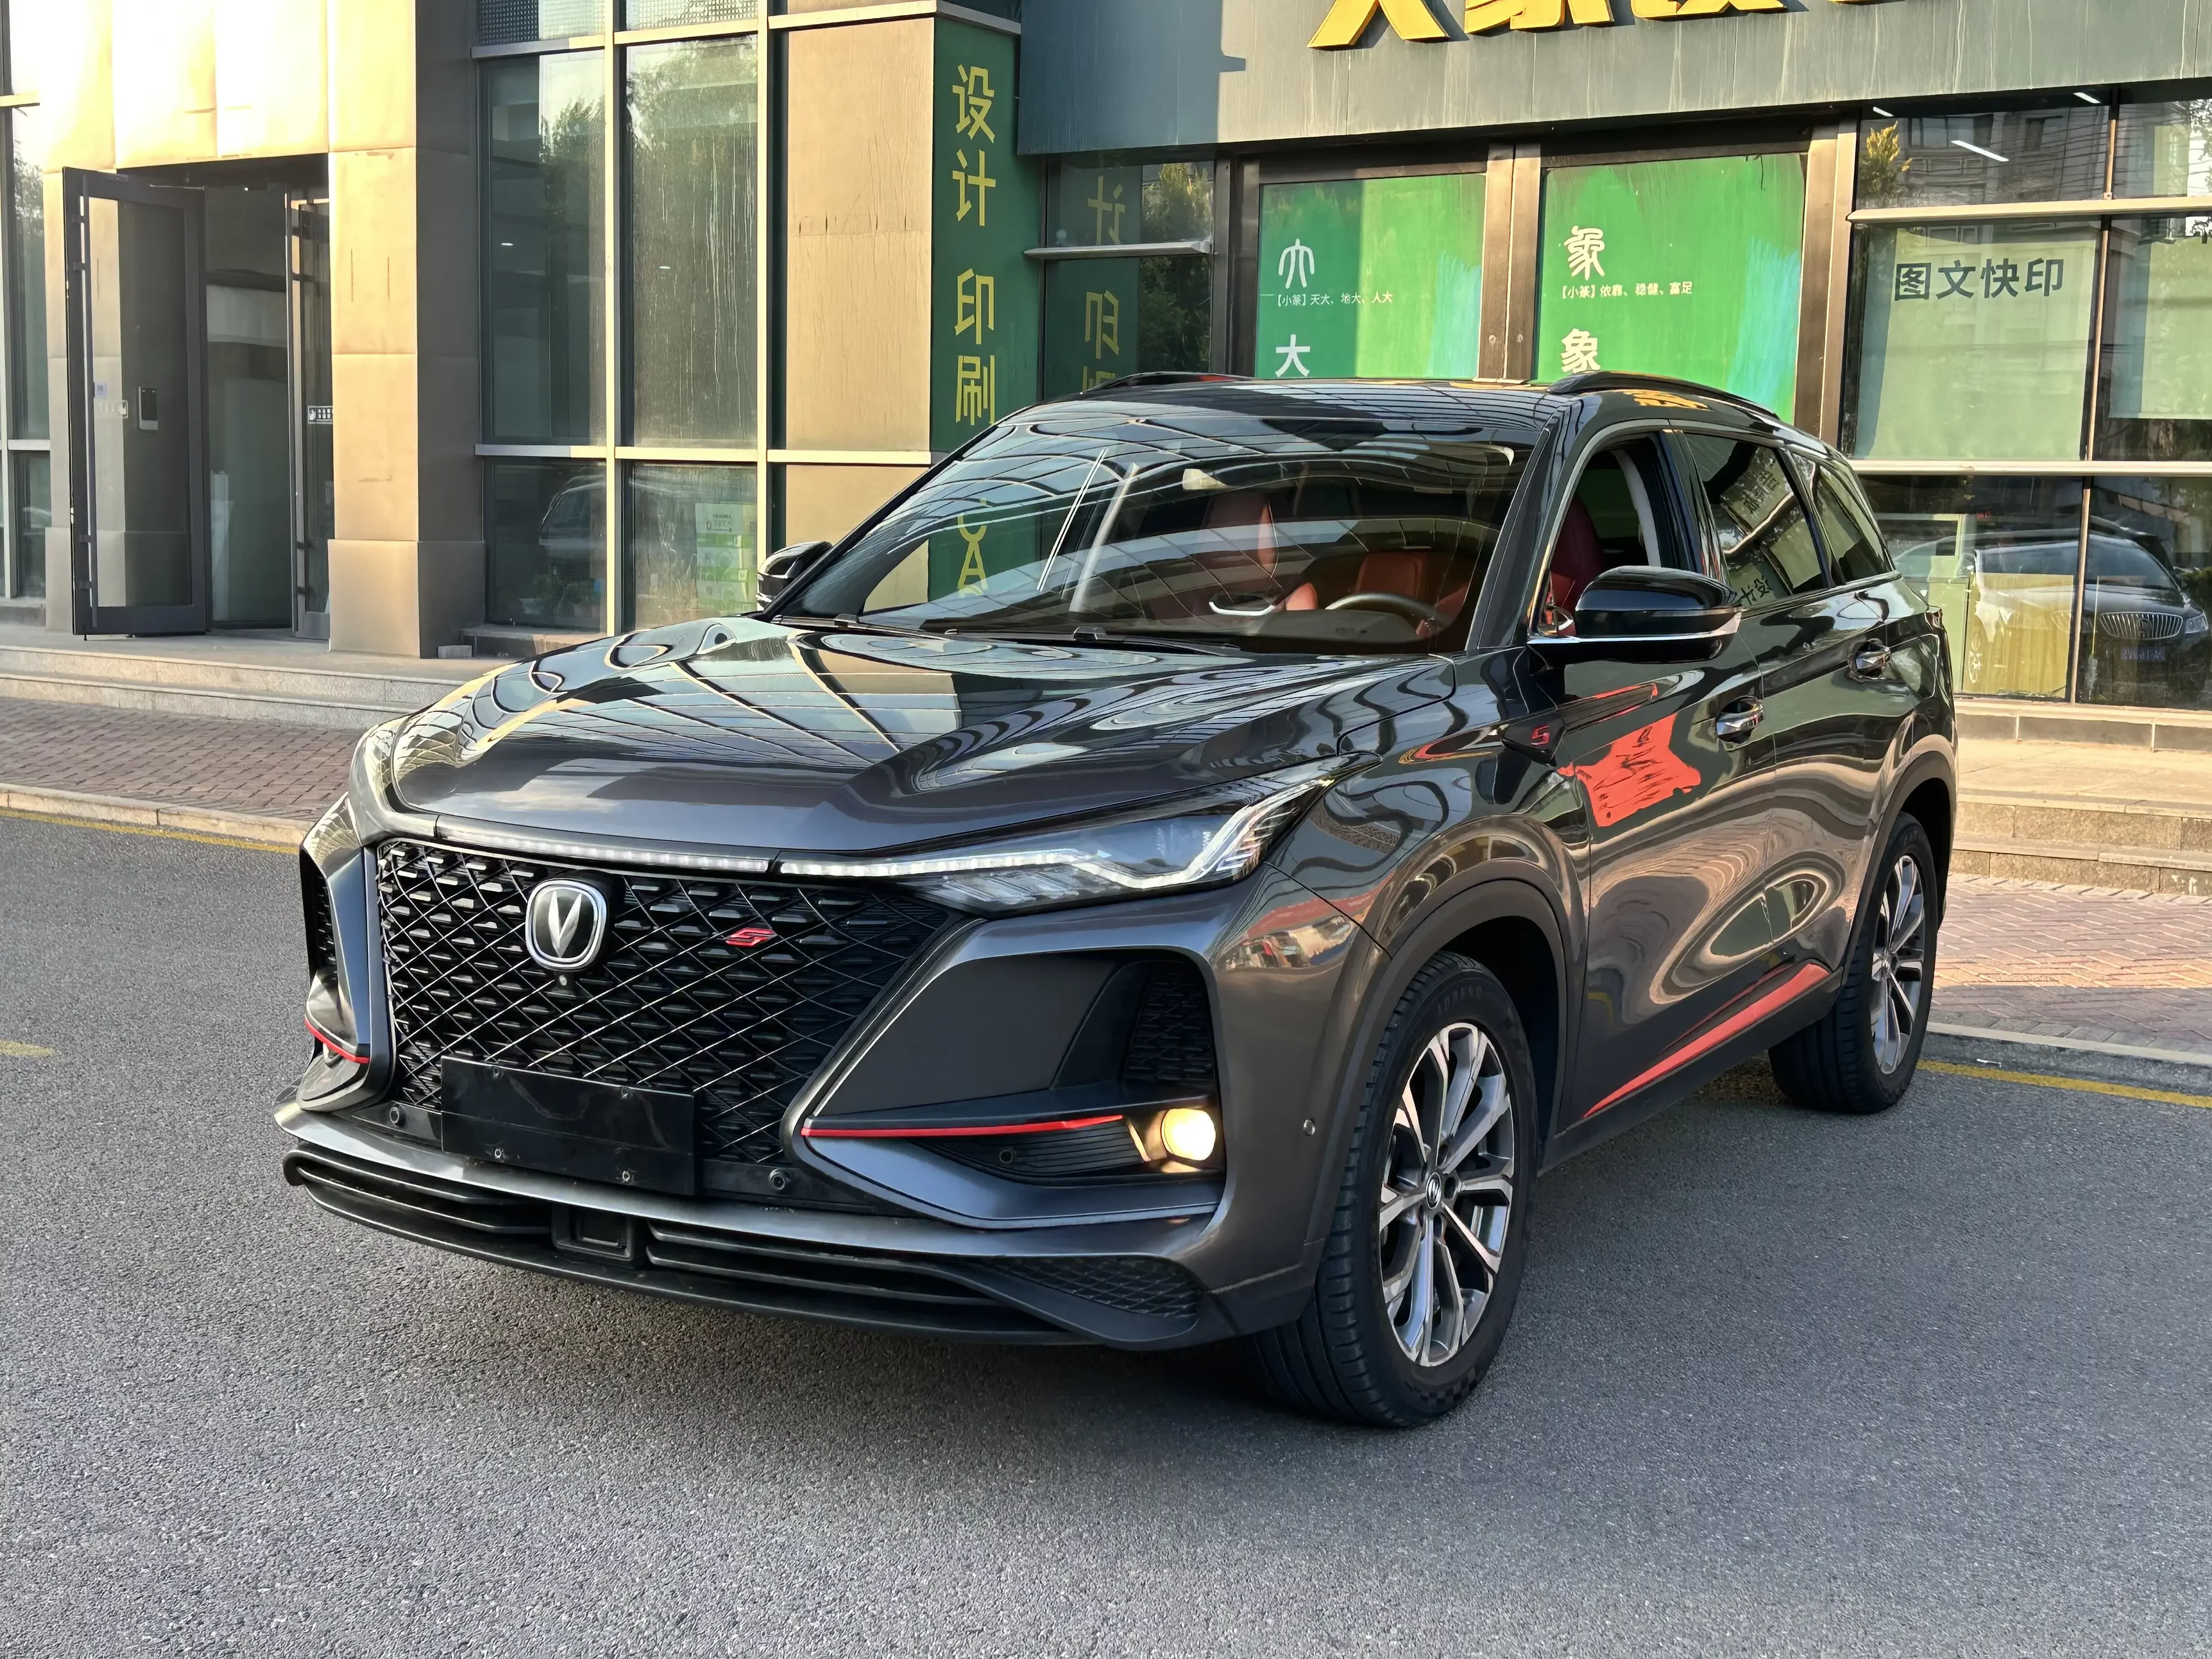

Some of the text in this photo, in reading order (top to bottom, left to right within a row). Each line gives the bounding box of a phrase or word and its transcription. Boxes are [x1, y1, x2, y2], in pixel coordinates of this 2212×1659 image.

[952, 64, 996, 425] 设计 印刷
[1894, 258, 2064, 301] 图文快印
[1275, 334, 1311, 377] 大
[1560, 328, 1601, 374] 象
